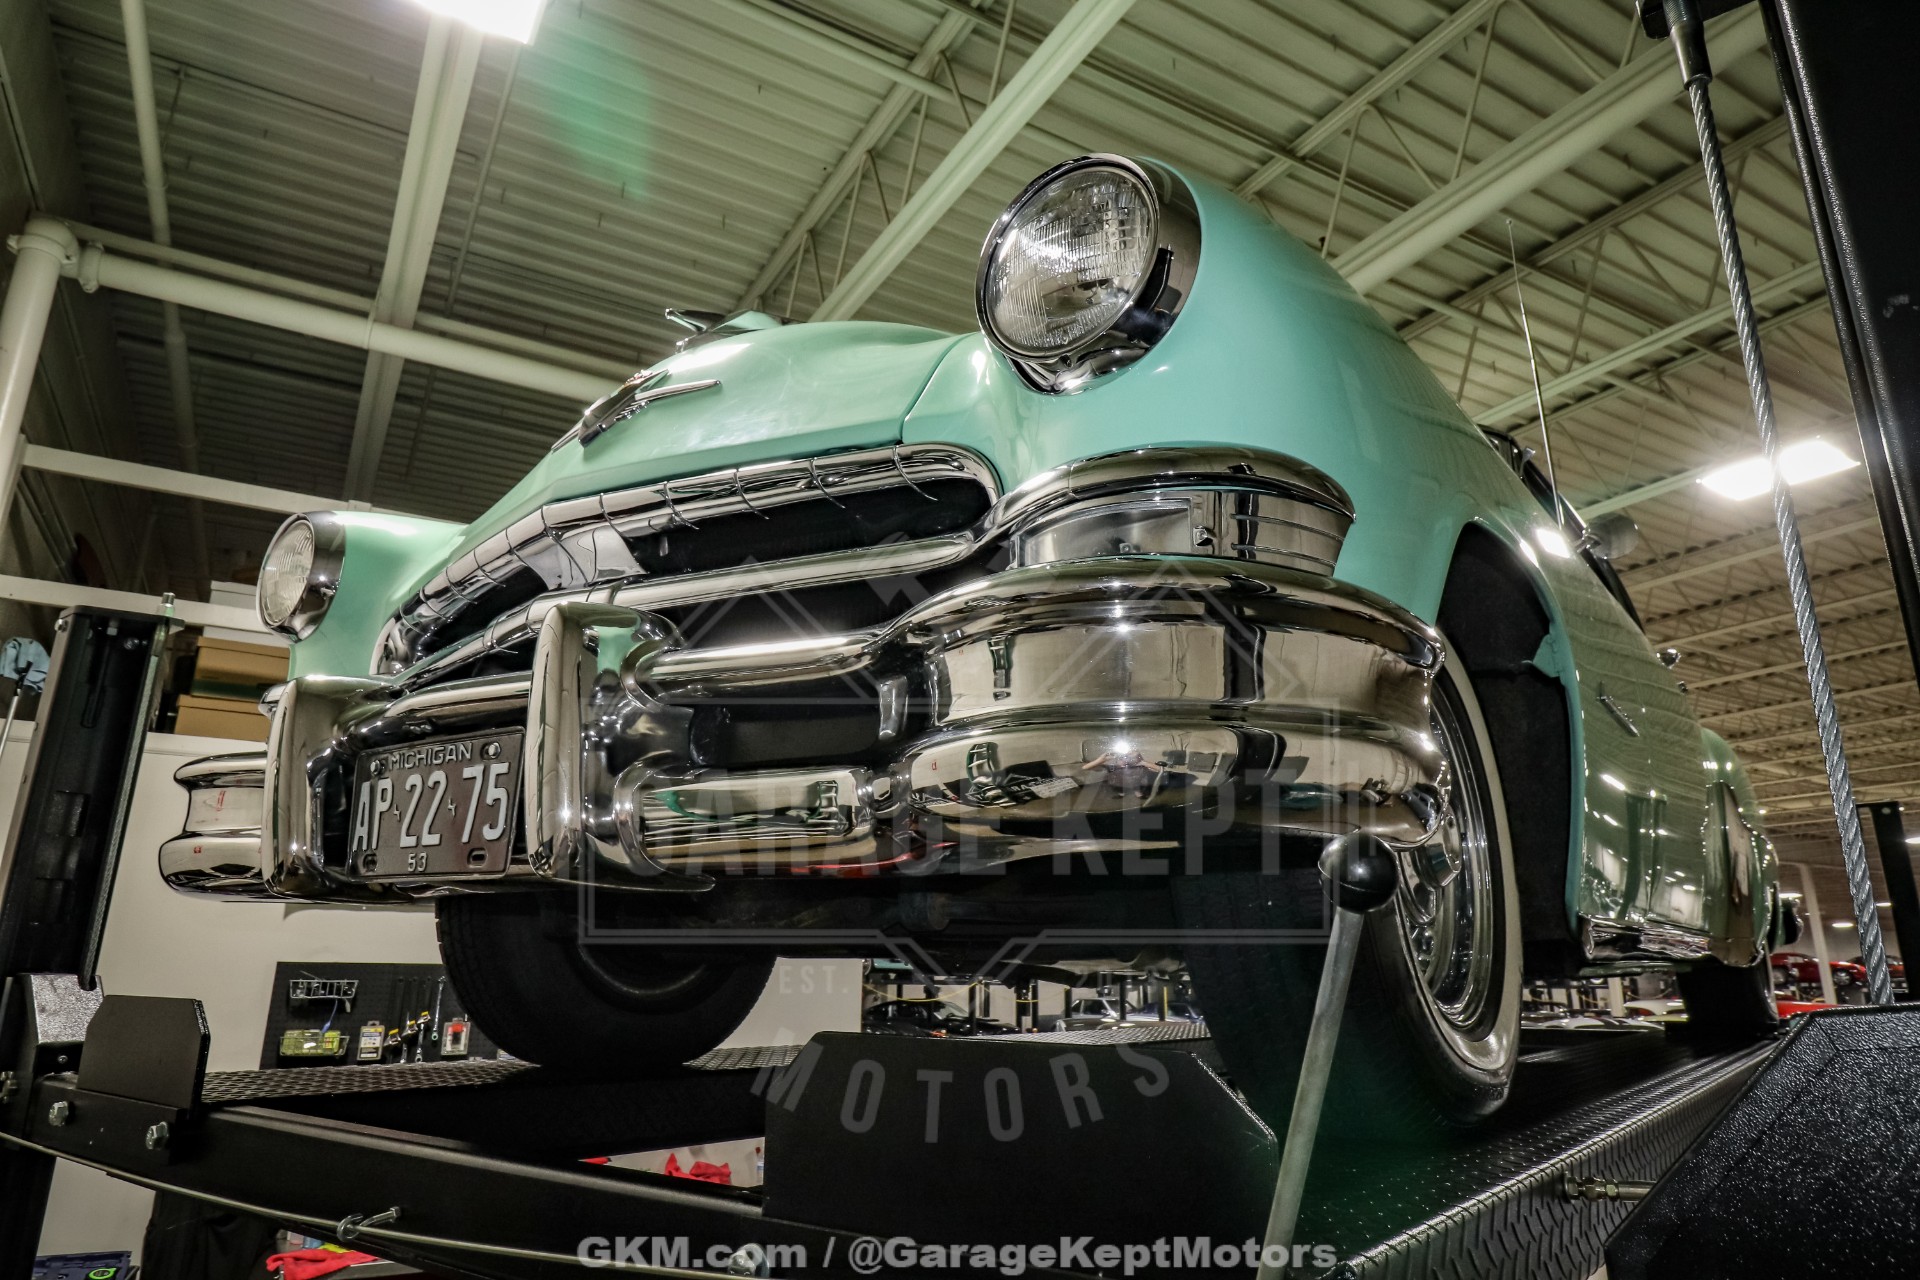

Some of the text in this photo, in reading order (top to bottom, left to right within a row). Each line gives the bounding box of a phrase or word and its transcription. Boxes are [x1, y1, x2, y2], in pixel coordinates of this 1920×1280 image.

[389, 741, 473, 772] MICHIGAN
[400, 770, 447, 848] 22
[461, 762, 510, 843] 75
[407, 851, 428, 873] 53
